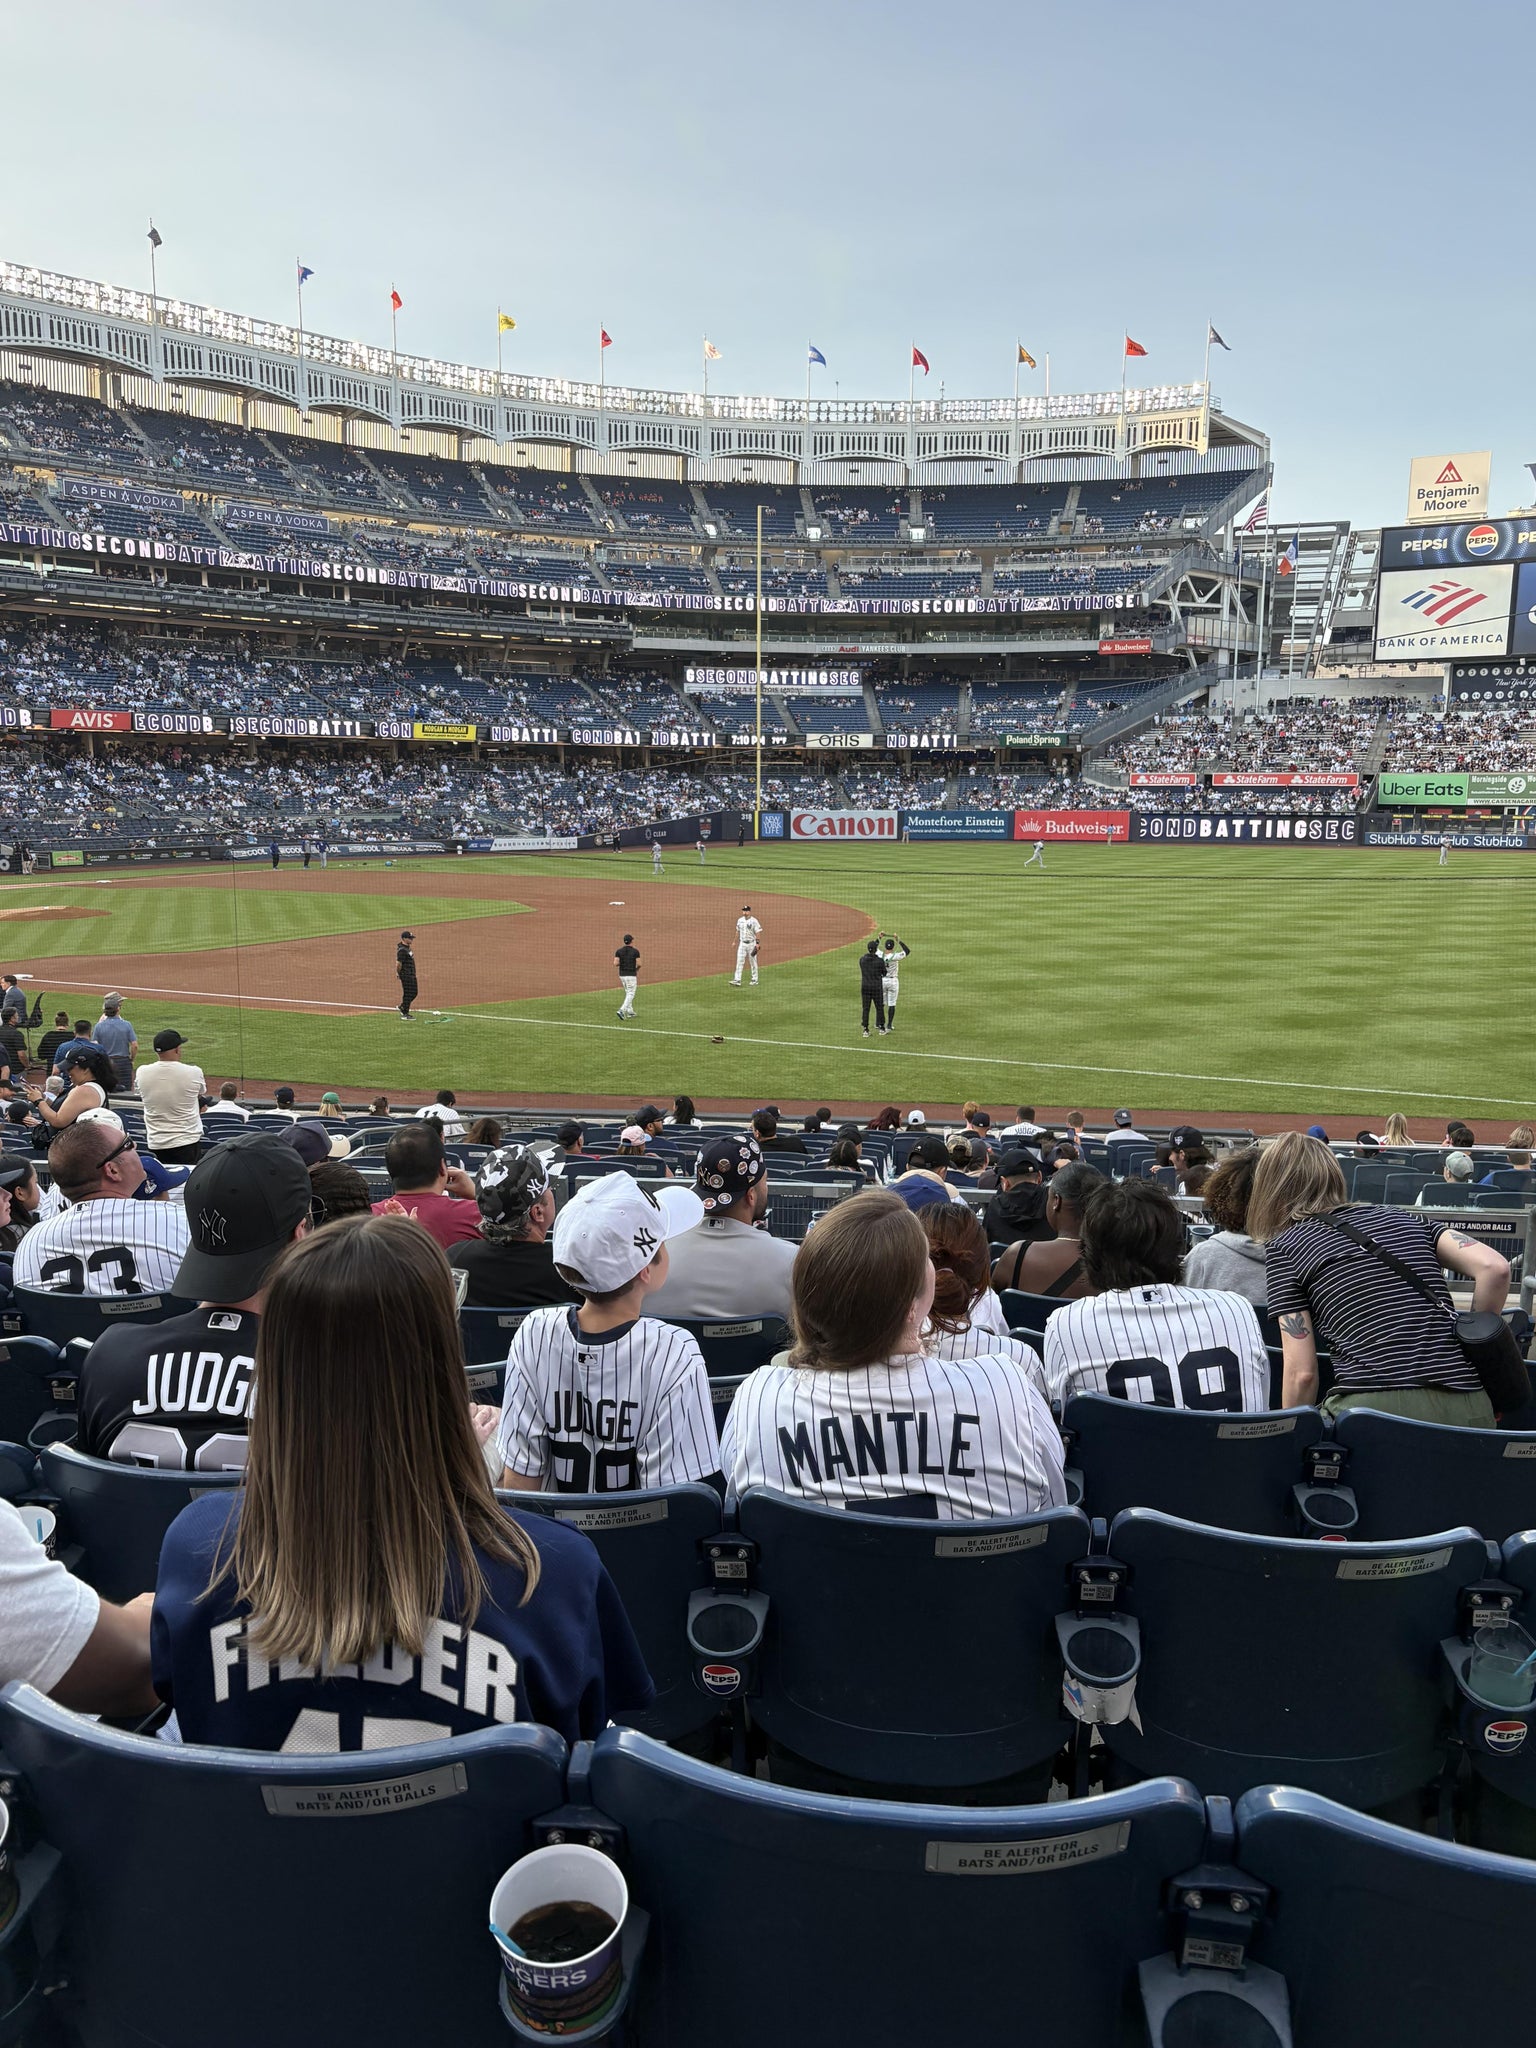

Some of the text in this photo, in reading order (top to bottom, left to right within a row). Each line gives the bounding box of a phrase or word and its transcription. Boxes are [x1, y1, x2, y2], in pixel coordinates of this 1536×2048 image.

[71, 484, 178, 509] ASPEN VODKA
[1417, 484, 1480, 500] Benjamin
[1424, 499, 1467, 512] Moore
[233, 508, 323, 530] ASPEN VODKA
[1401, 538, 1448, 552] PEPSI
[1468, 536, 1497, 545] PEPSI
[1114, 643, 1149, 651] Budweiser
[1379, 633, 1504, 648] BANK OF AMERICA
[71, 712, 115, 728] AVIS
[731, 735, 750, 745] 7:10
[819, 734, 860, 747] ORIS
[1006, 734, 1061, 747] Poland Spring
[1471, 775, 1508, 784] Morningside
[1383, 783, 1463, 796] Uber Eats
[763, 821, 781, 830] YORK
[764, 815, 780, 823] NEW
[792, 813, 895, 836] Canon
[908, 816, 1005, 827] Montefiore Einstein
[765, 827, 780, 835] LIFE
[1369, 833, 1417, 845] StubHub
[1473, 834, 1523, 847] StubHub
[1467, 1223, 1491, 1231] AND/OR
[546, 1390, 639, 1443] JUDGE
[778, 1411, 980, 1488] MANTLE
[594, 1517, 627, 1526] AND/OR
[628, 1513, 652, 1522] BALLS
[597, 1511, 622, 1519] ALERT
[622, 1509, 638, 1517] FOR
[975, 1543, 1007, 1552] AND/OR
[1009, 1538, 1032, 1548] BALLS
[1379, 1566, 1411, 1575] AND/OR
[1412, 1562, 1435, 1572] BALLS
[1410, 1558, 1425, 1566] FOR
[210, 1614, 518, 1724] FIDER
[704, 1672, 739, 1683] PEPSI
[1487, 1729, 1526, 1740] PEPSI
[296, 1785, 437, 1811] BATS AND/OR BALLS
[316, 1782, 412, 1801] BE ALERT FOR
[958, 1843, 1099, 1868] BATS AND/OR BALLS
[984, 1840, 1078, 1859] BE ALERT FOR
